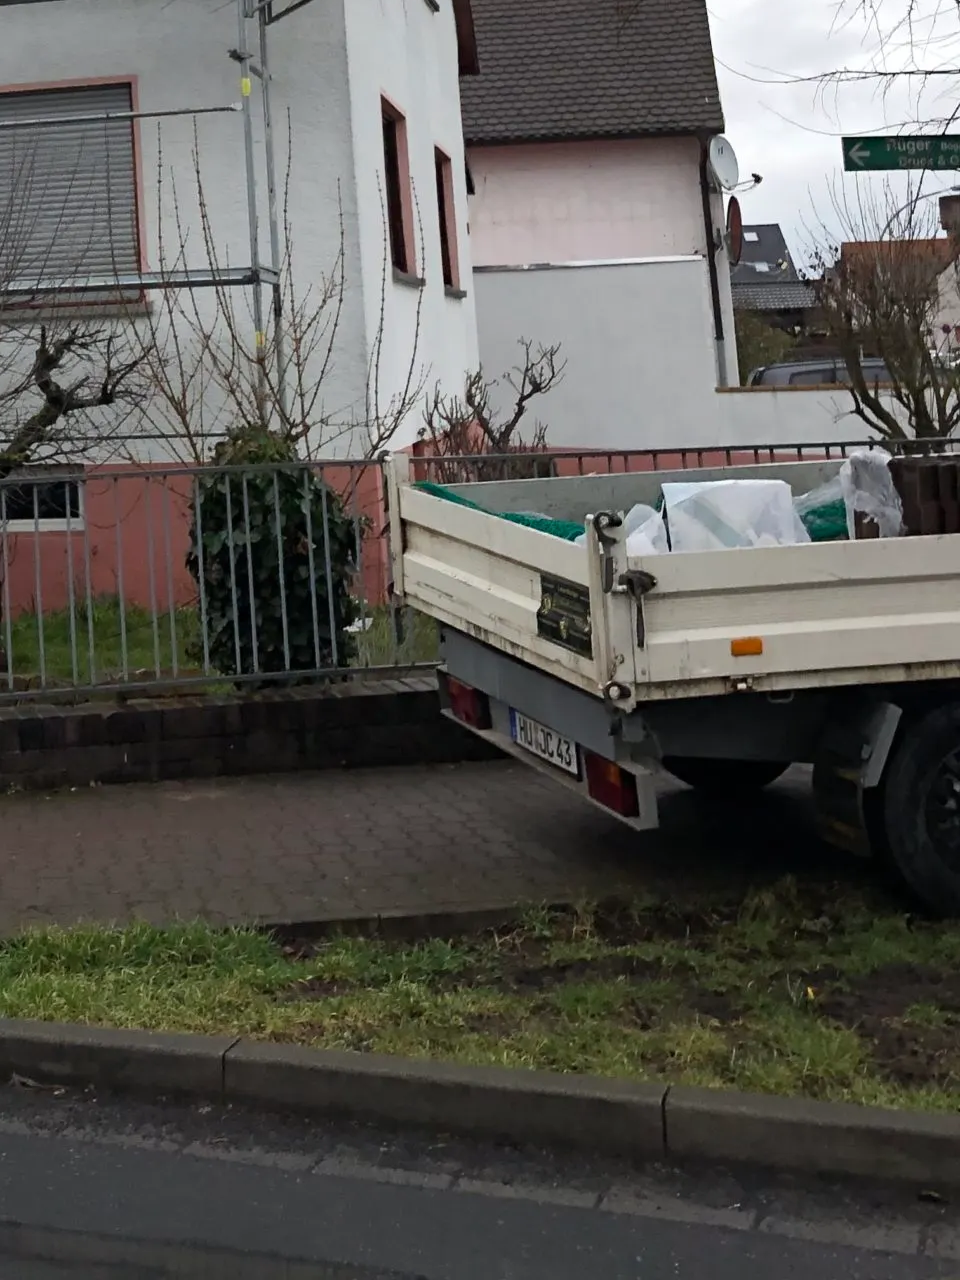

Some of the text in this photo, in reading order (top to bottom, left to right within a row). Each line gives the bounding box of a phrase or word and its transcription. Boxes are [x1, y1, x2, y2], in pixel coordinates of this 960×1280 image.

[937, 155, 946, 167] &
[519, 716, 533, 746] HU
[557, 737, 572, 767] 43
